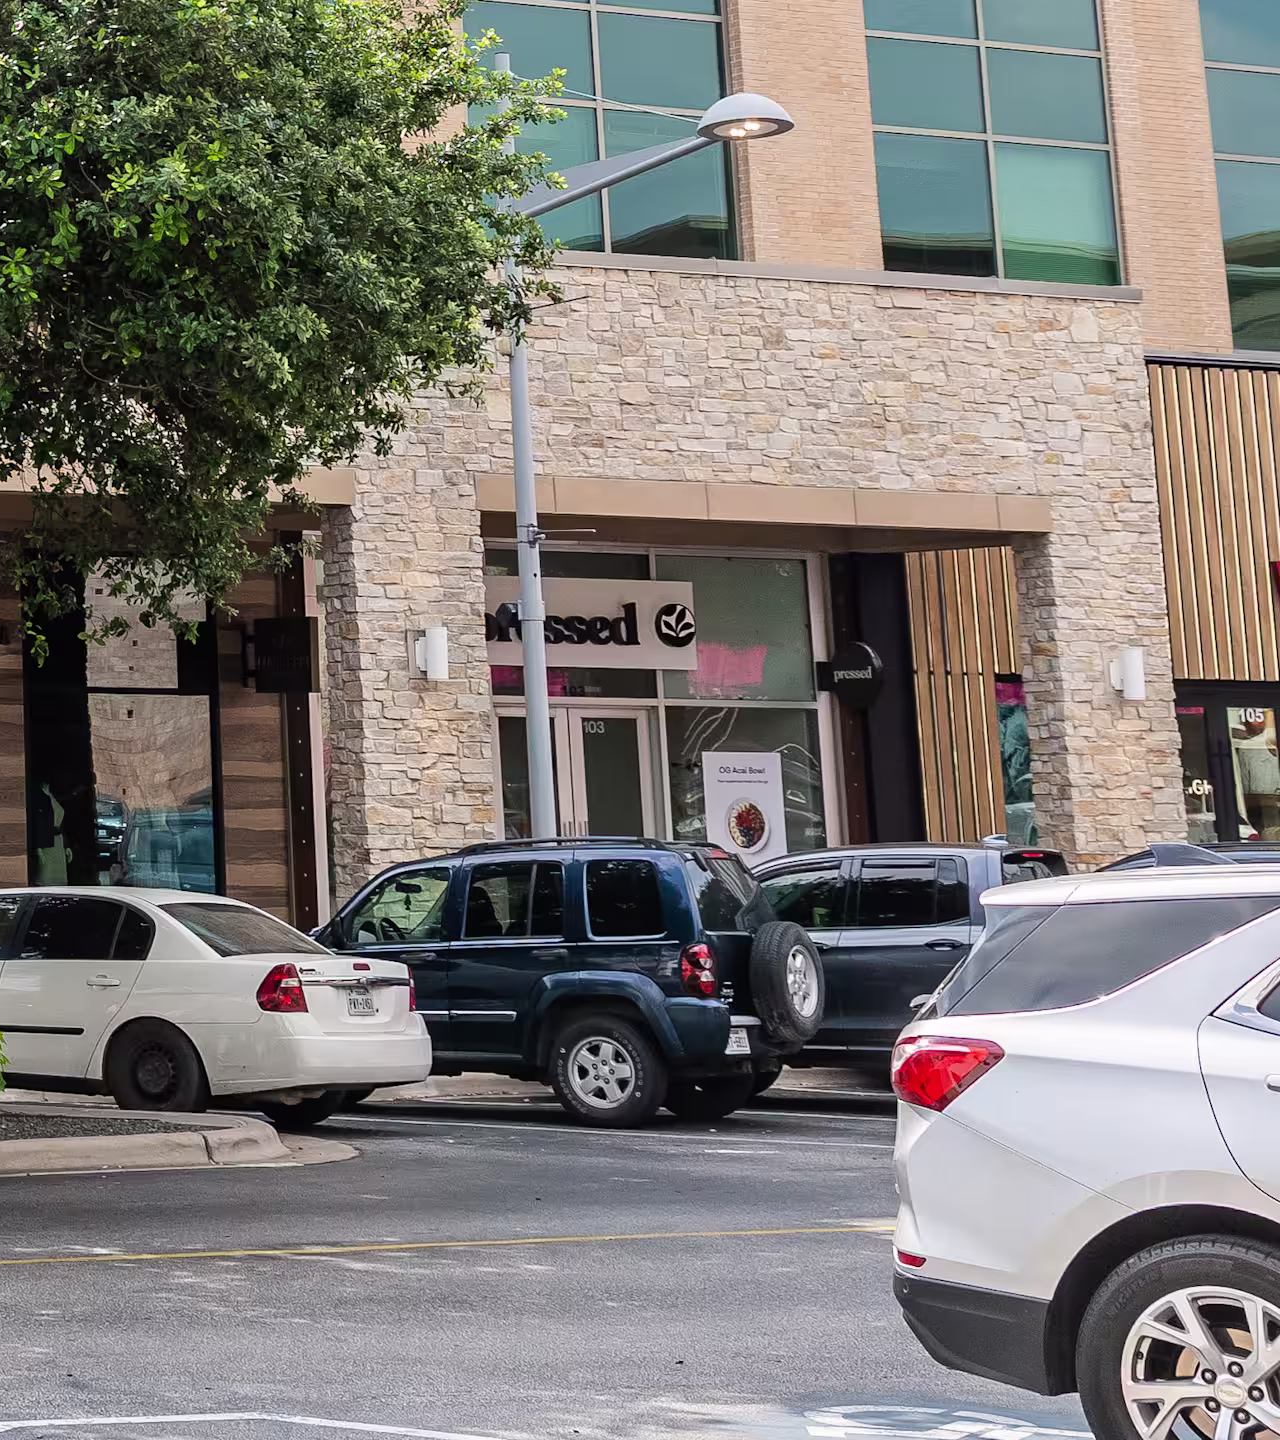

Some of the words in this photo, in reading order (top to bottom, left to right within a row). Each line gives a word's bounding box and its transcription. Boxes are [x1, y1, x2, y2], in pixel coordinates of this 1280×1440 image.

[833, 665, 873, 683] pressed
[1239, 707, 1265, 723] 105
[583, 720, 605, 734] 103
[719, 766, 731, 774] OG
